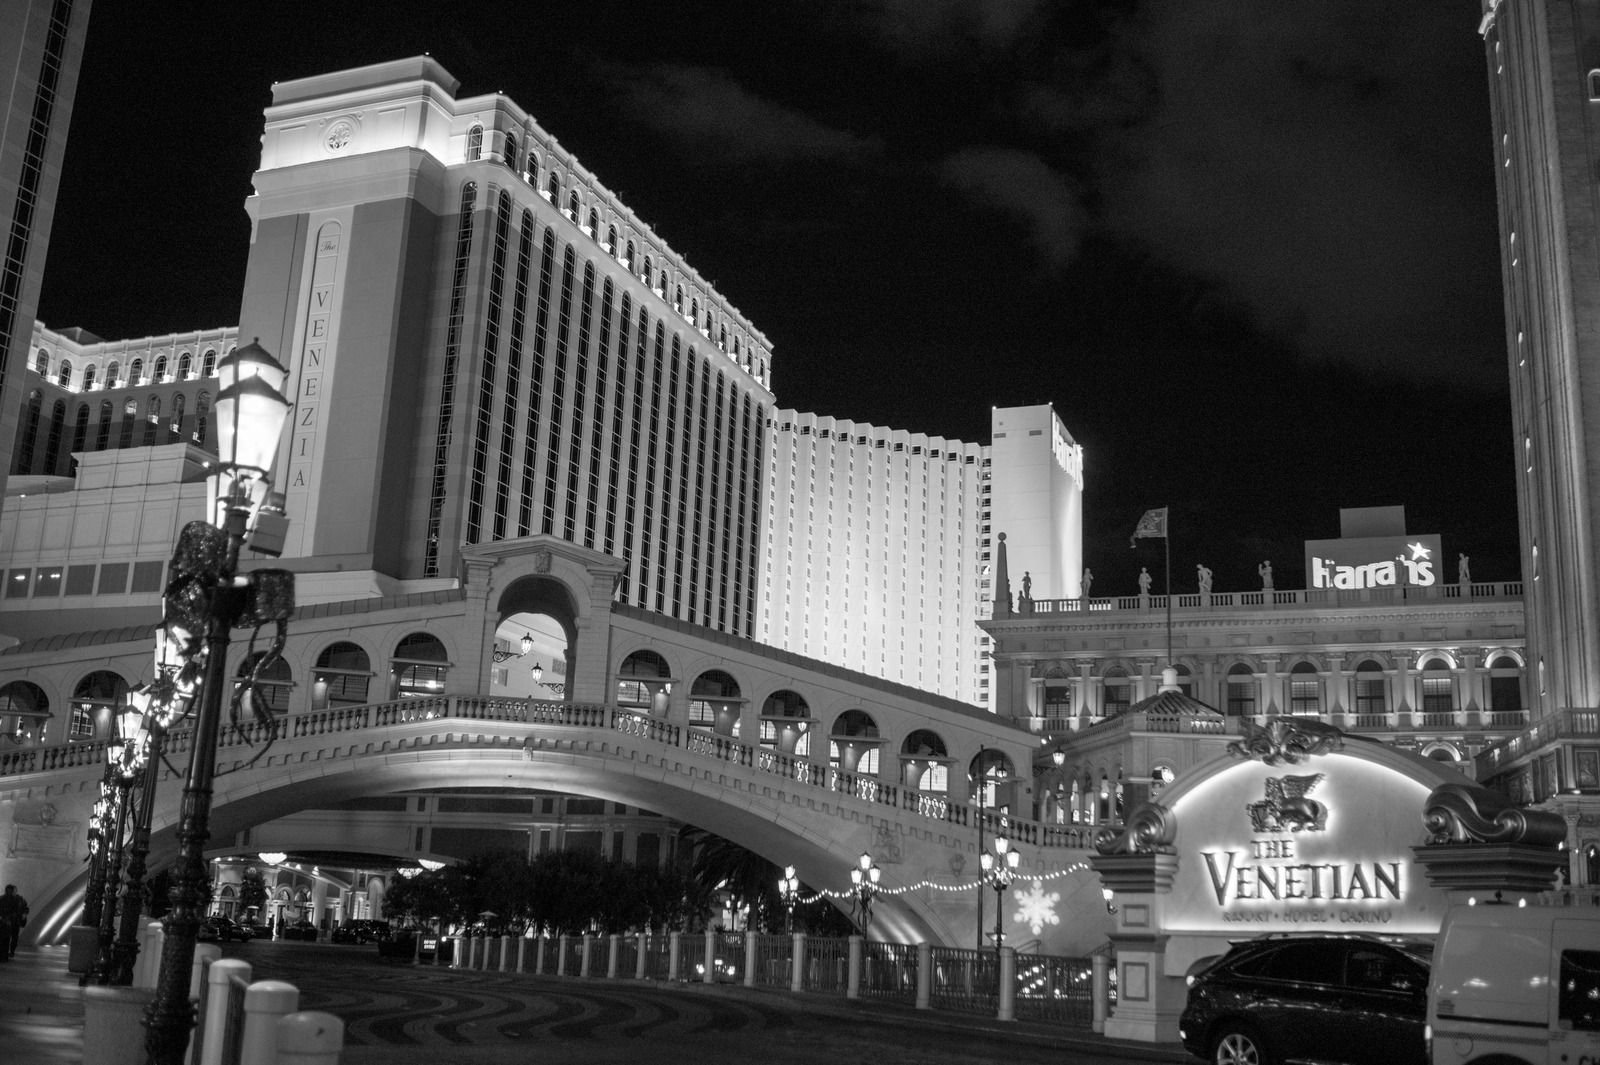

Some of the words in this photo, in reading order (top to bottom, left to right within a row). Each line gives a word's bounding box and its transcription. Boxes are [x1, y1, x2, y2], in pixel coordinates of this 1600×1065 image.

[293, 291, 329, 487] VENEZIA
[1250, 839, 1294, 860] THE
[1200, 851, 1402, 906] VENETIAN
[1222, 911, 1272, 923] RESORT
[1282, 909, 1328, 924] HOTEL
[1338, 910, 1393, 924] CASINO
